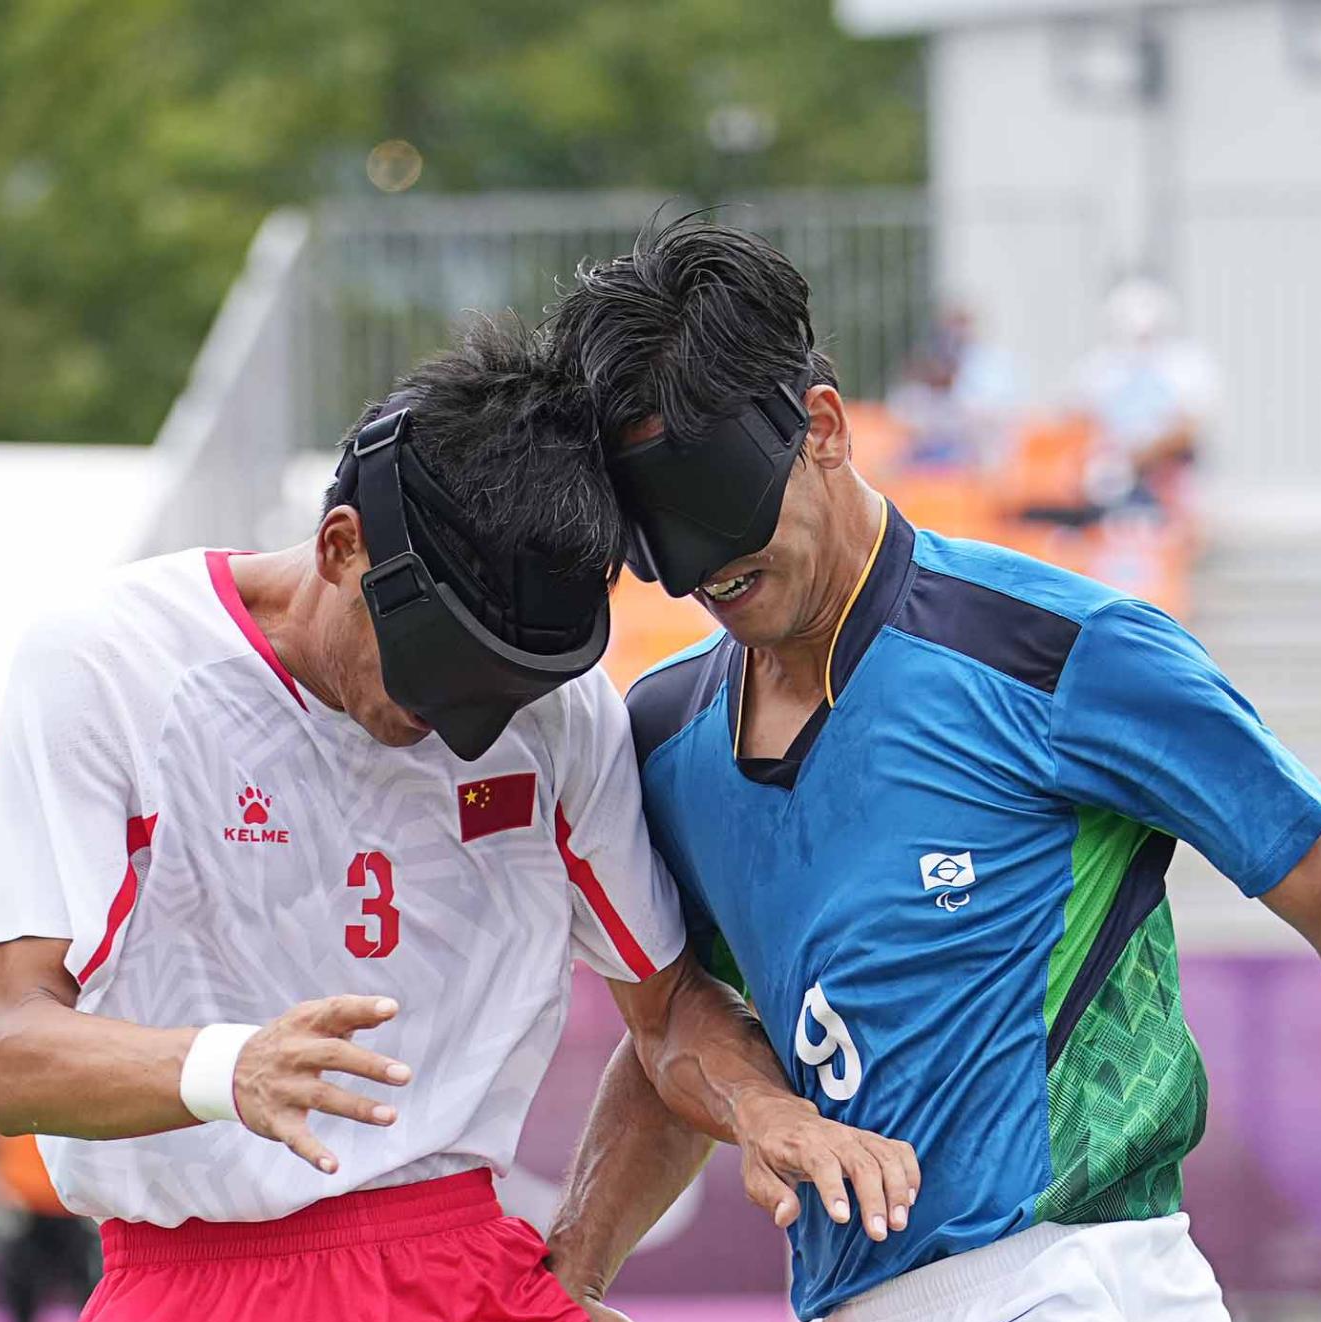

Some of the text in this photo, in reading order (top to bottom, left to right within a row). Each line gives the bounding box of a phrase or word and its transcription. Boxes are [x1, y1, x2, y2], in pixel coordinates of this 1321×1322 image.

[224, 828, 289, 844] KELME
[345, 851, 400, 959] 3
[795, 981, 862, 1101] 9
